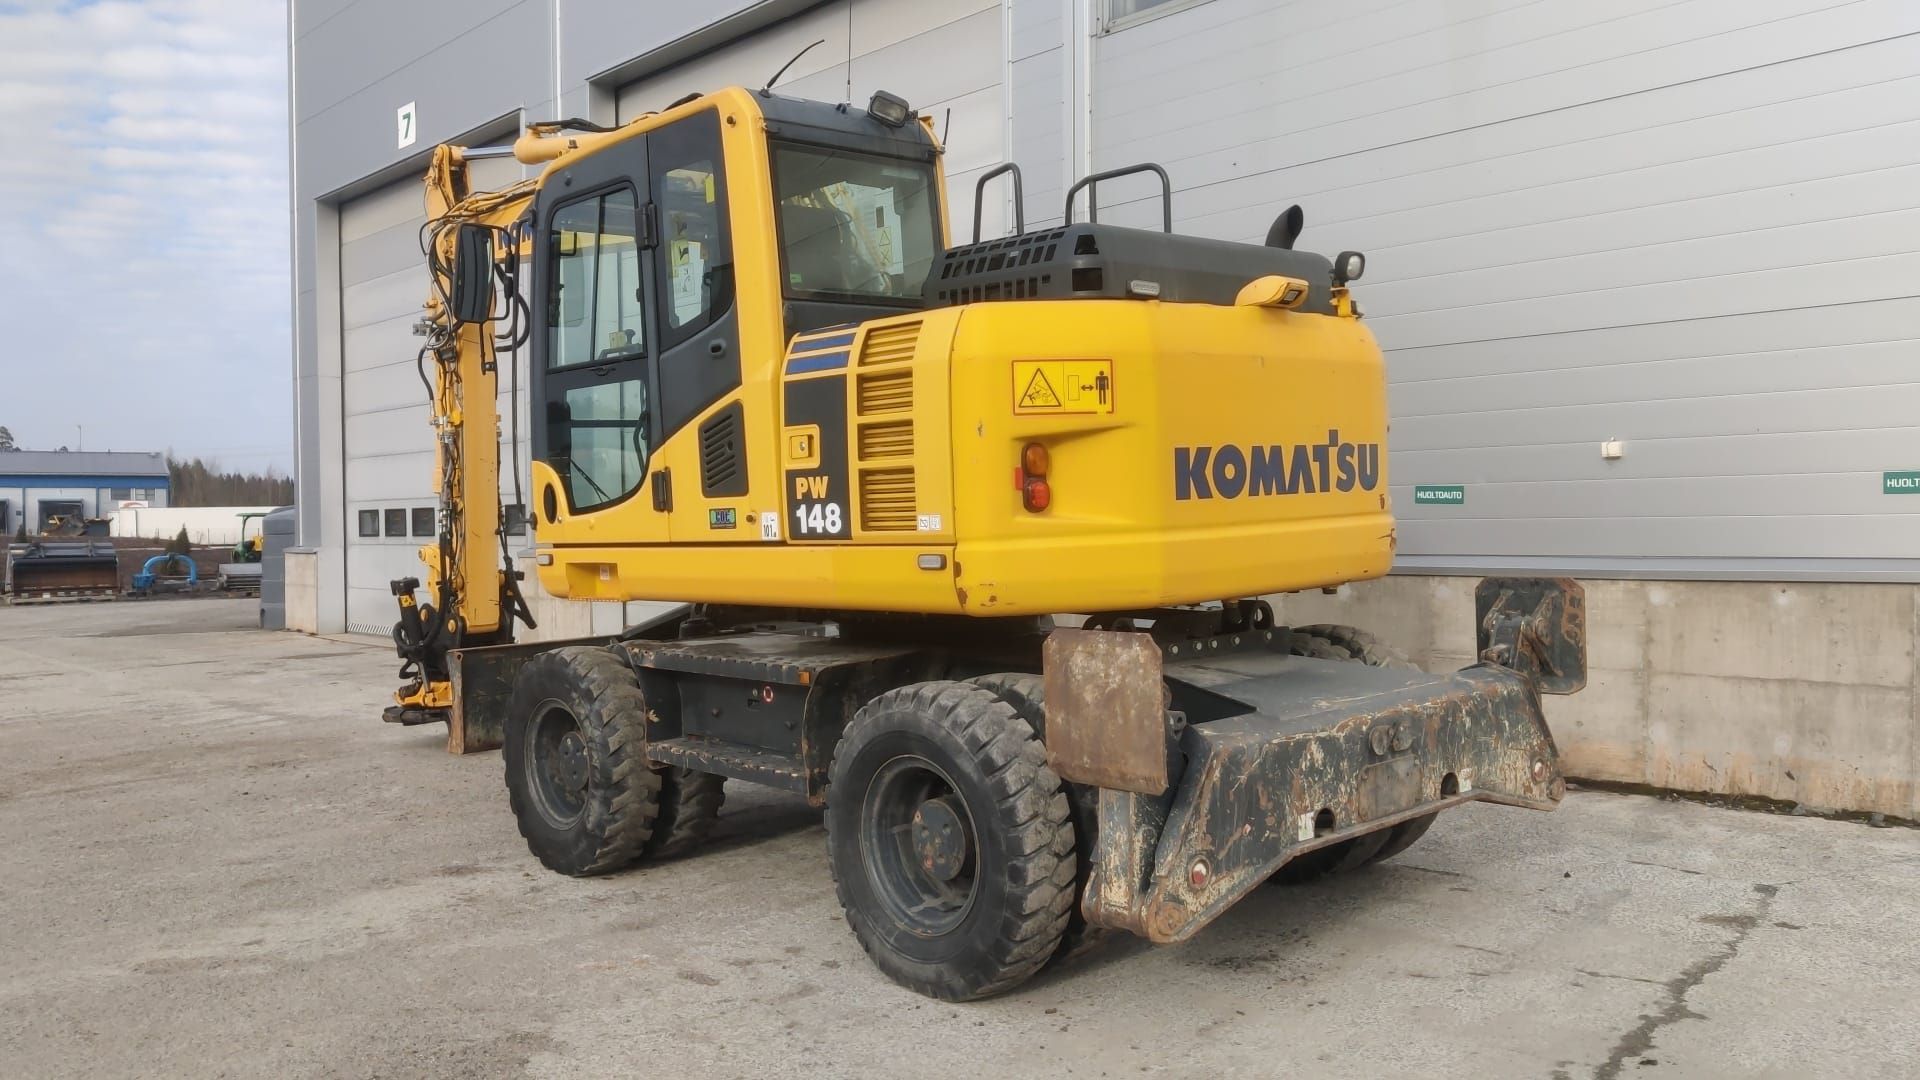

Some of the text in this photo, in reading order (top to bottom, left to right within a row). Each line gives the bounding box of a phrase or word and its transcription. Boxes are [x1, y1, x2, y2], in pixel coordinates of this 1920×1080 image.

[402, 112, 411, 139] 7
[1174, 429, 1379, 500] KOMATSU
[795, 476, 828, 500] PW
[1417, 490, 1463, 499] HUOLTOAUTO
[1887, 478, 1920, 488] HUOLT
[796, 502, 842, 534] 148
